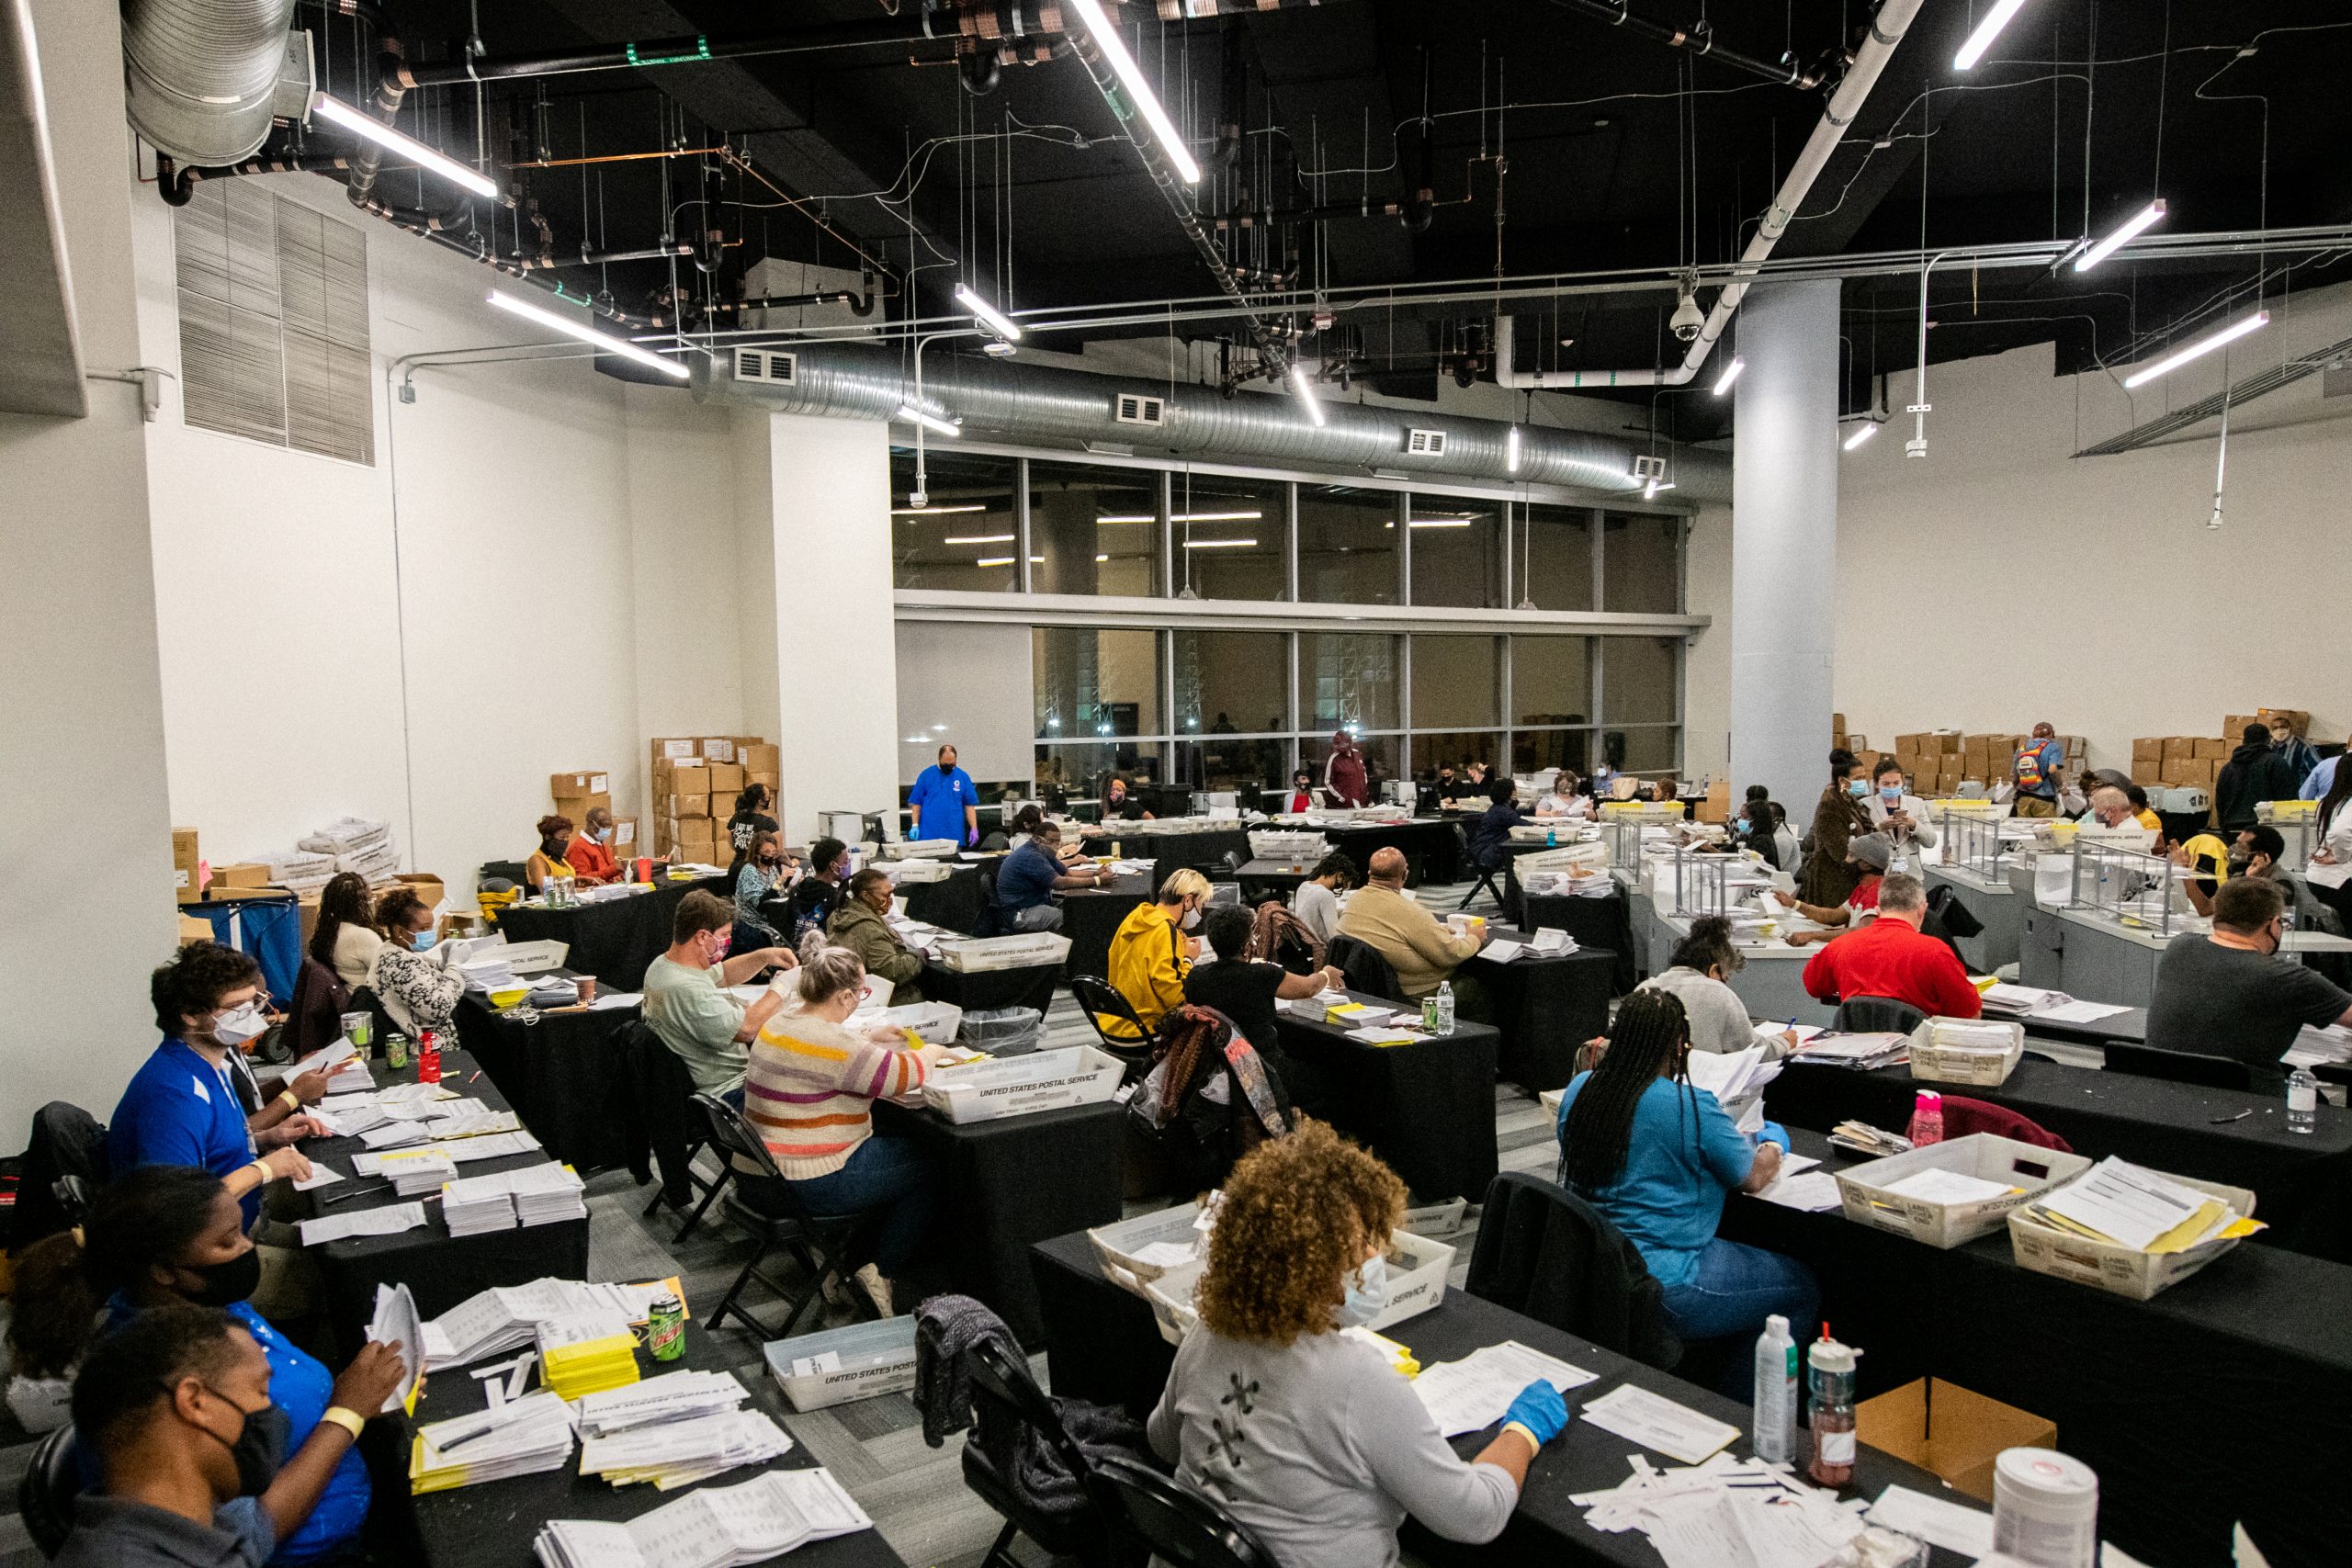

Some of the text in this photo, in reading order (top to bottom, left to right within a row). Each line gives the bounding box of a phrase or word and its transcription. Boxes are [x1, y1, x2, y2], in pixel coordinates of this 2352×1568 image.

[1035, 944, 1055, 953] SERVICE
[915, 1020, 940, 1031] SERVICE
[979, 1073, 1098, 1098] UNITED STATES POSTAL SERVICE
[1392, 1282, 1429, 1306] SERVICE
[825, 1372, 857, 1384] UNITED
[859, 1367, 891, 1379] STATES
[892, 1359, 918, 1372] POSTA
